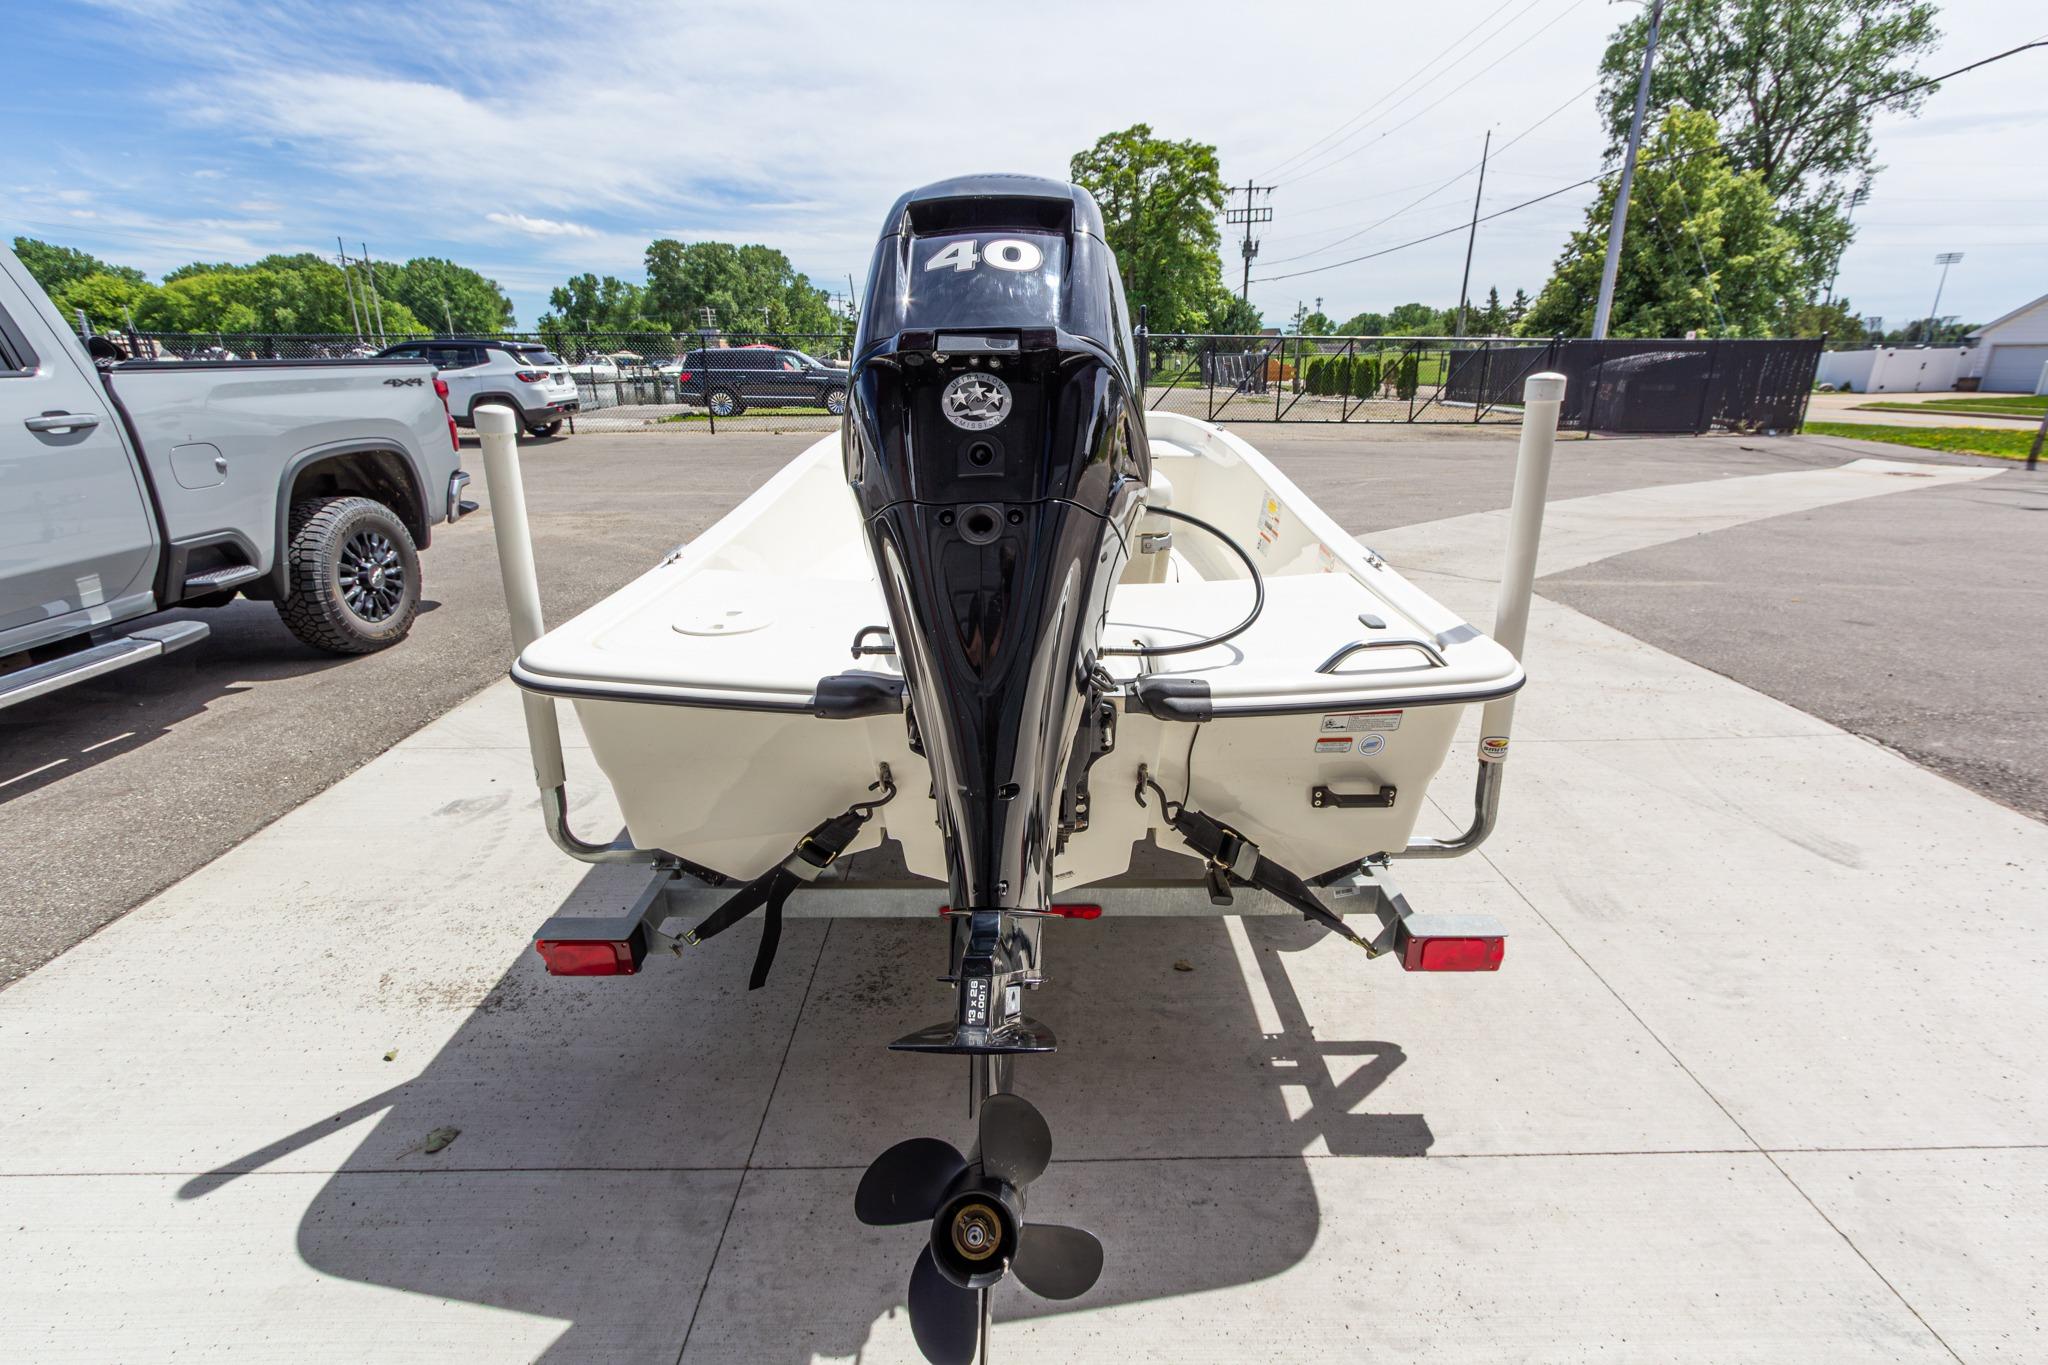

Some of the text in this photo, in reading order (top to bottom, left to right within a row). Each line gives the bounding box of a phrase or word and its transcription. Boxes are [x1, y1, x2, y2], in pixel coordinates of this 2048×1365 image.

[924, 239, 1044, 273] 40
[950, 374, 1006, 390] ULTRA LOW
[953, 416, 1001, 430] EMISSION
[970, 980, 978, 997] 26
[977, 985, 986, 1019] 2.00:1
[968, 1010, 976, 1024] 13
